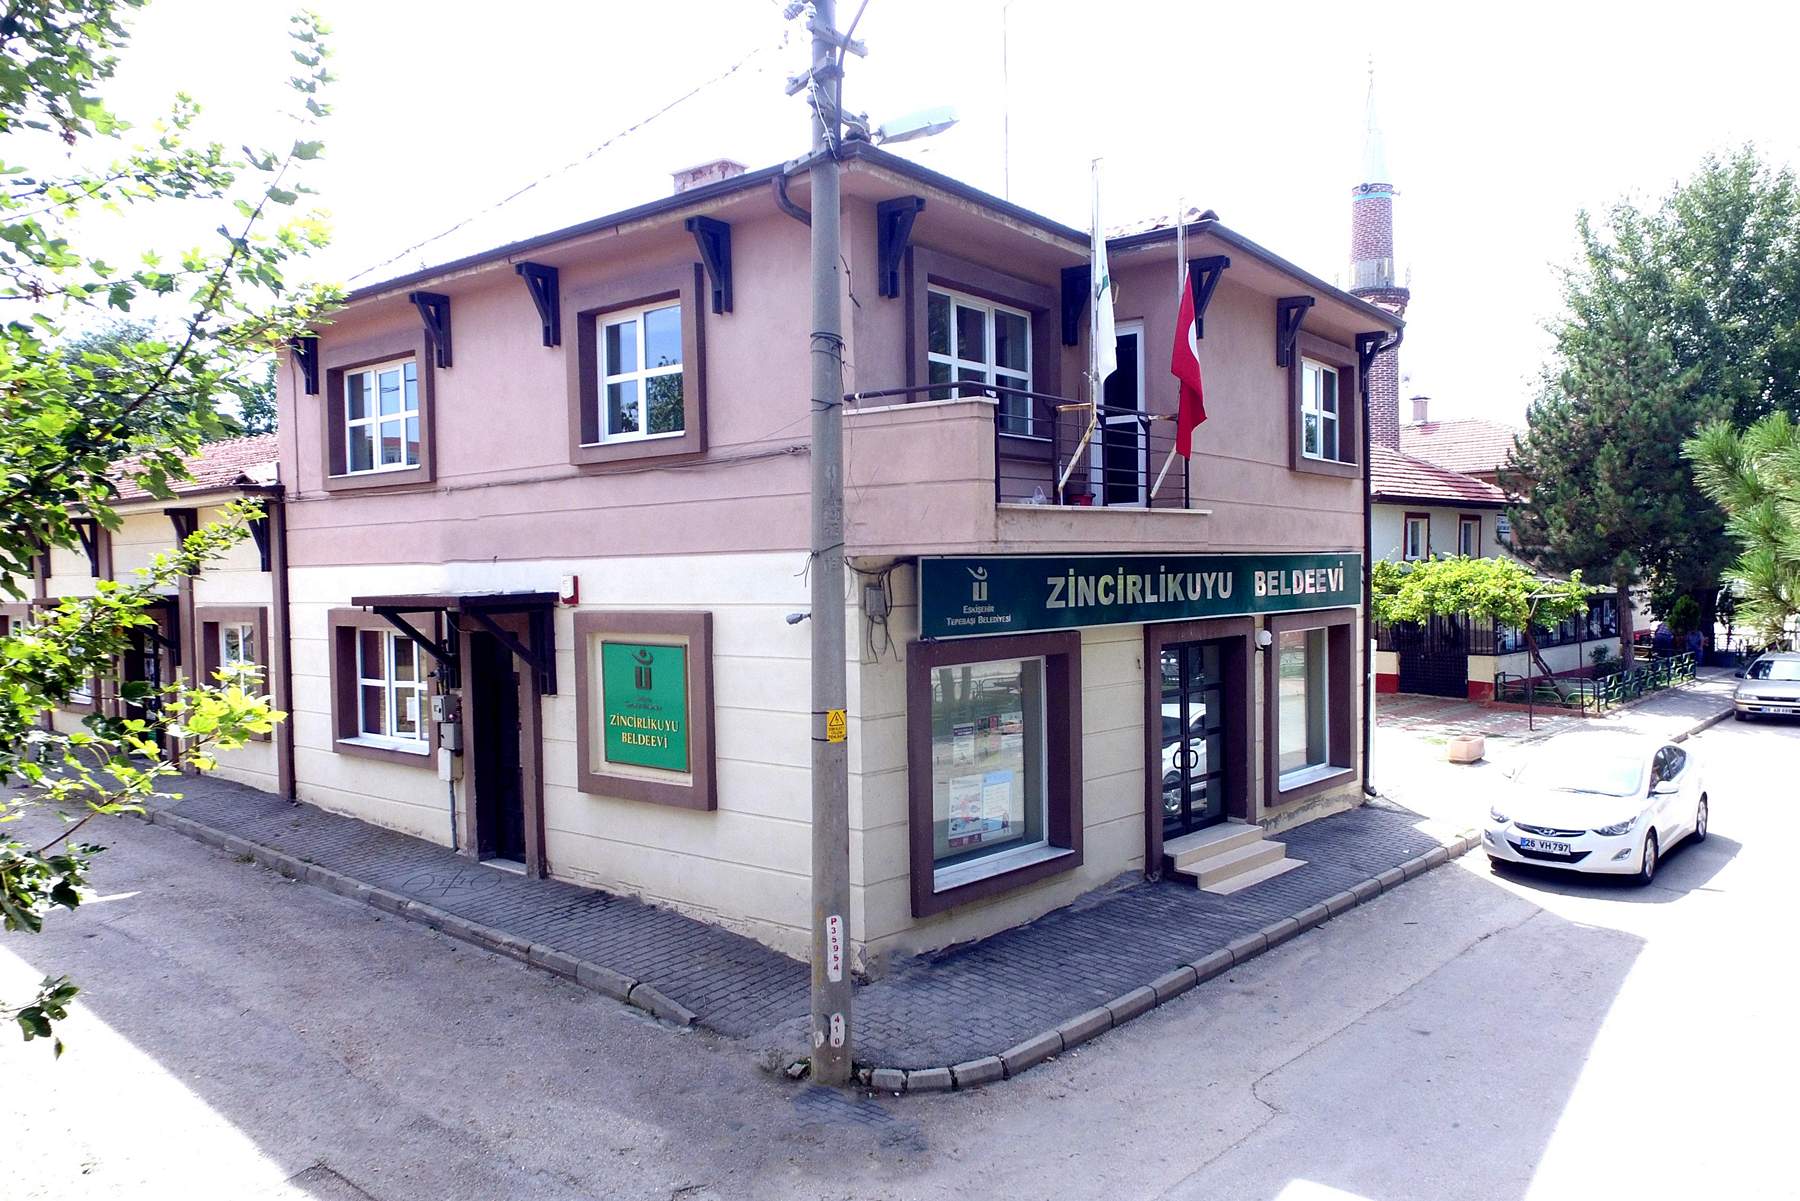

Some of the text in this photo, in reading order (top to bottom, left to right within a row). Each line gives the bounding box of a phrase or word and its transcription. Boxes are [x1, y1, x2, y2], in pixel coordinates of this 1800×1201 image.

[1046, 561, 1344, 608] ZİNCİRLİKUYU BELDEEVİ
[610, 714, 679, 732] ZİNCİRLİKUYU
[622, 732, 667, 748] BELDEEVİ
[1526, 840, 1568, 852] 26 VH 797
